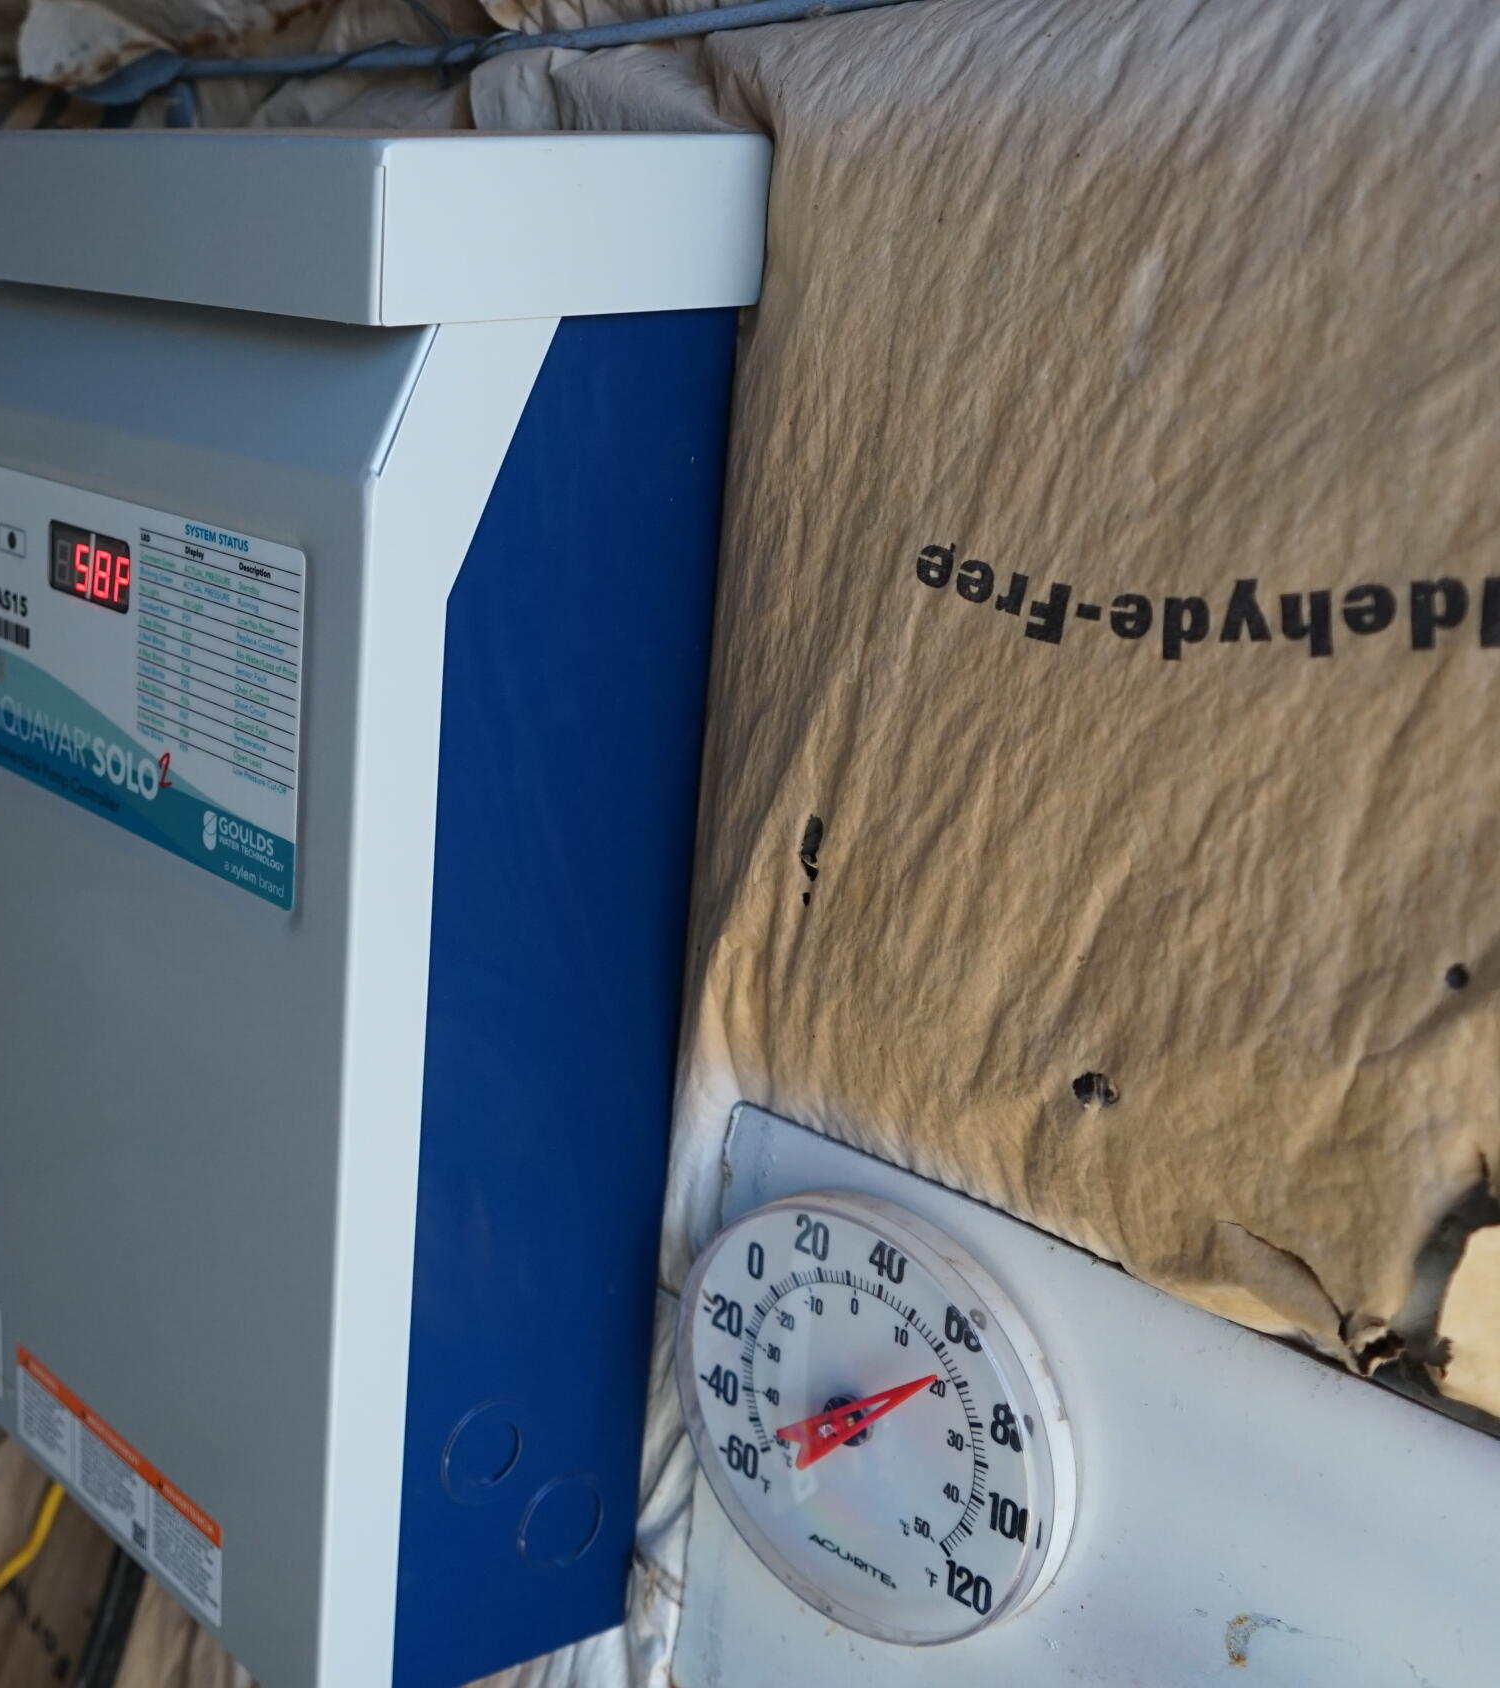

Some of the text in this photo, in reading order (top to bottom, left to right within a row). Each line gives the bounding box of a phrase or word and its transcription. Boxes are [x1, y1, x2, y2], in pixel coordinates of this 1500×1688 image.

[185, 524, 249, 553] SYSTEM STATUS
[185, 546, 204, 560] Display
[238, 562, 271, 579] Description
[219, 817, 274, 856] GOULDS
[219, 835, 285, 872] WATER TECHNOLOGY
[224, 861, 284, 897] a xylem brand
[795, 1214, 829, 1261] 20
[748, 1242, 764, 1280] 0
[869, 1239, 908, 1284] 40
[704, 1293, 743, 1338] -20
[804, 1295, 823, 1316] -10
[850, 1298, 859, 1316] 0
[776, 1311, 795, 1331] -20
[894, 1326, 909, 1347] 10
[700, 1364, 738, 1407] -40
[929, 1379, 946, 1398] 20
[947, 1429, 964, 1451] 30
[719, 1434, 758, 1480] -60
[942, 1482, 960, 1503] 40
[913, 1516, 930, 1538] 50
[946, 1559, 992, 1615] 120
